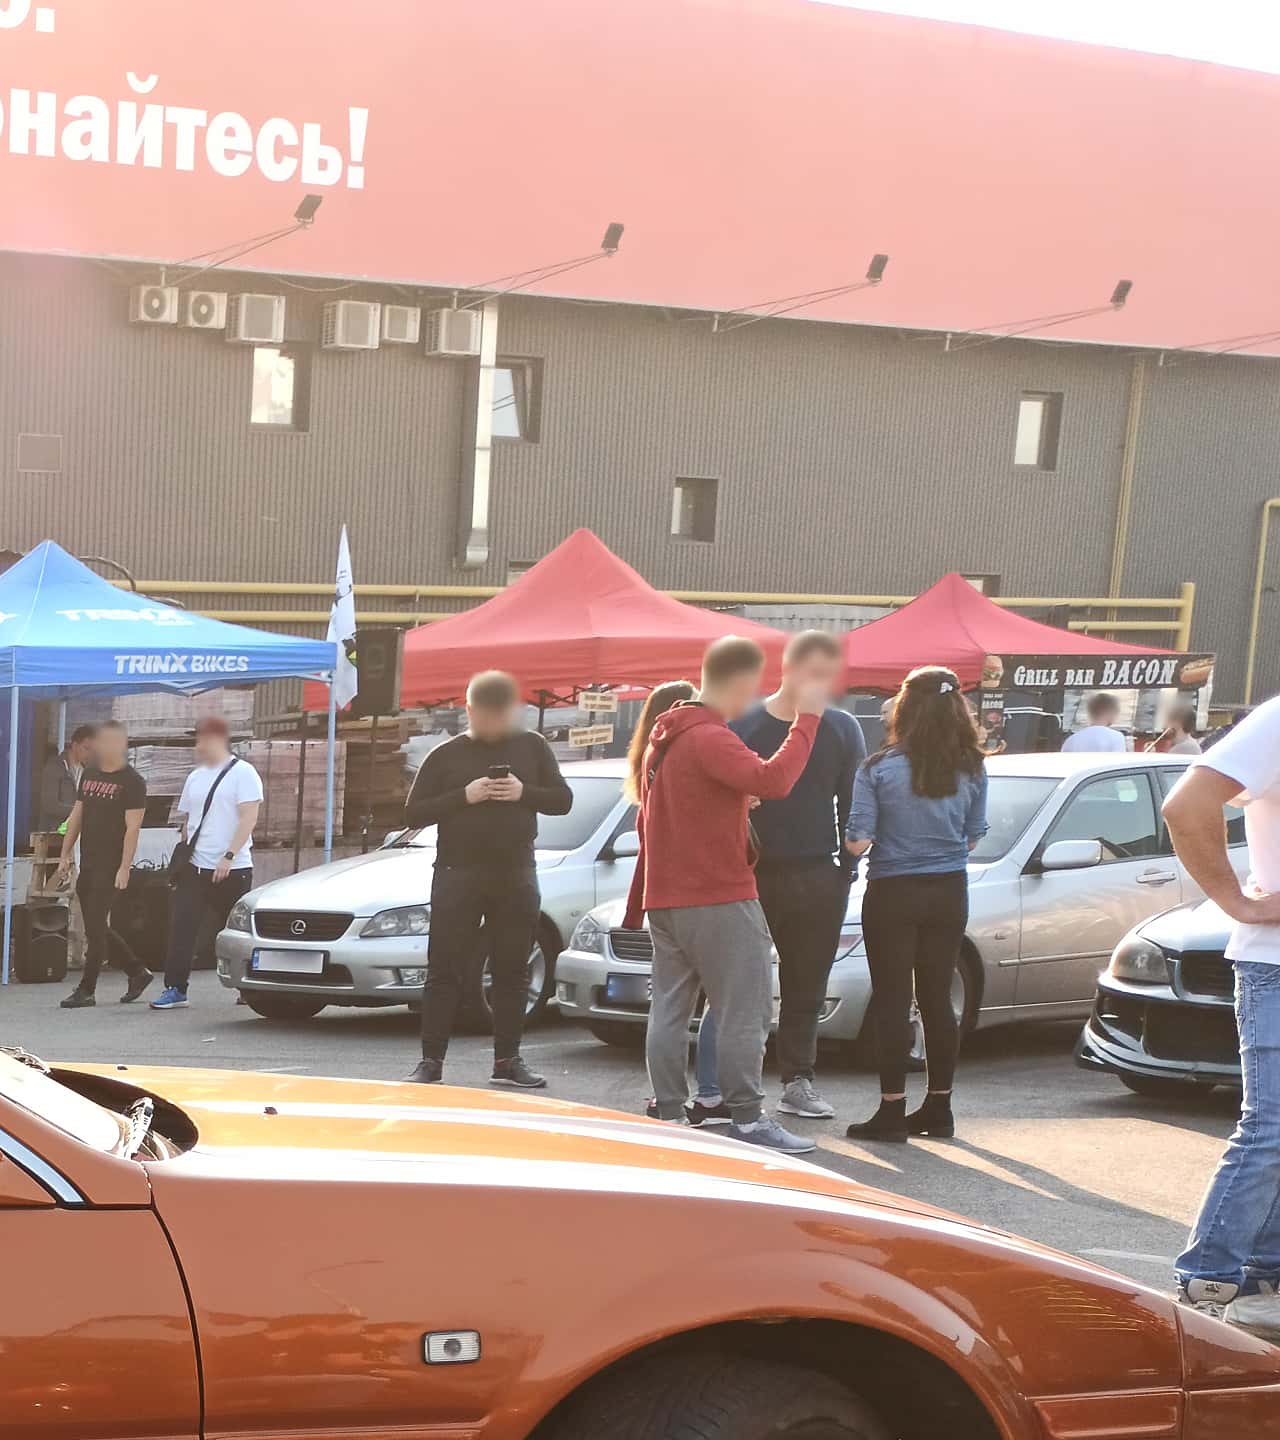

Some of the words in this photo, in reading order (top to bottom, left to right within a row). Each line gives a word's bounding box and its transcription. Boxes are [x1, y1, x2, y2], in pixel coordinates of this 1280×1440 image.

[115, 652, 188, 675] TRINX
[191, 655, 250, 673] BIKES
[1099, 659, 1179, 685] BACON
